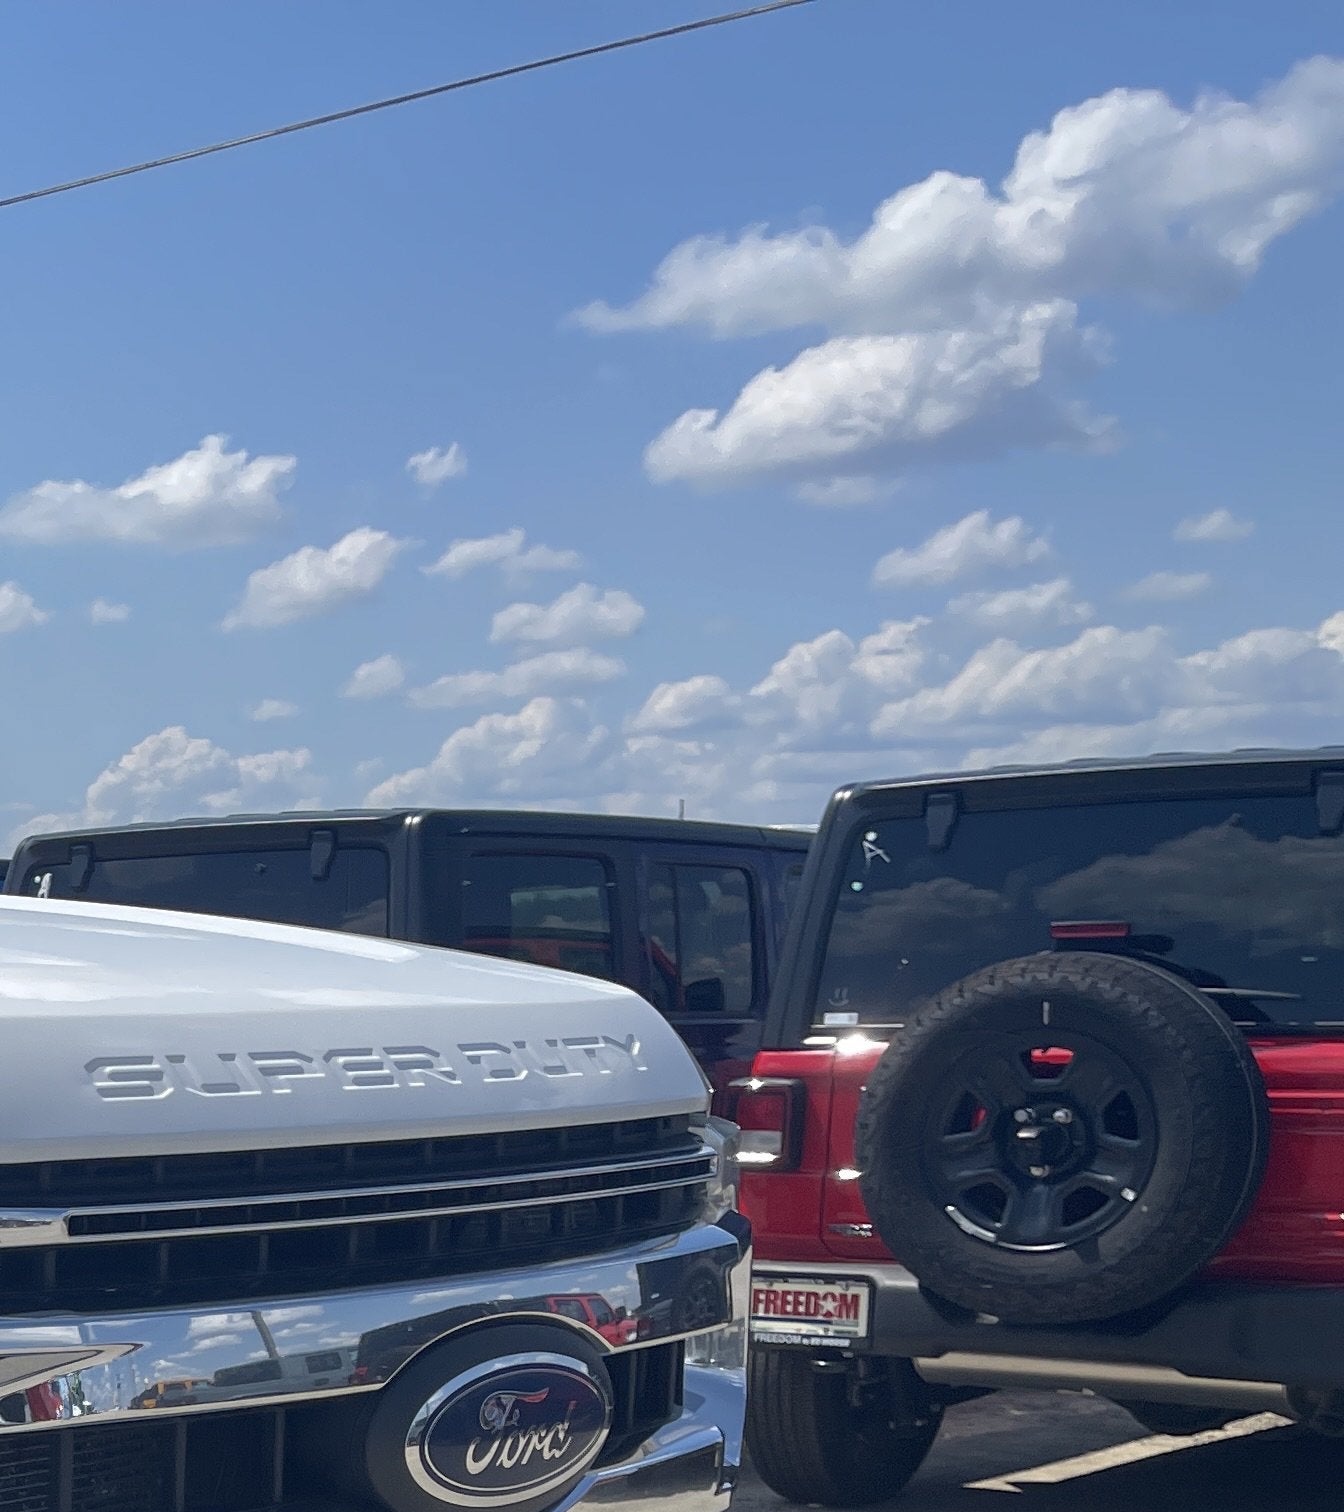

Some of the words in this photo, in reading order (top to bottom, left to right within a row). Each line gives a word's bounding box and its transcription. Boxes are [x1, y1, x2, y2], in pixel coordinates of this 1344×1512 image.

[84, 1045, 462, 1101] SUPER
[458, 1034, 647, 1083] DUTY
[752, 1288, 861, 1320] FREEDOM
[466, 1388, 577, 1475] Ford
